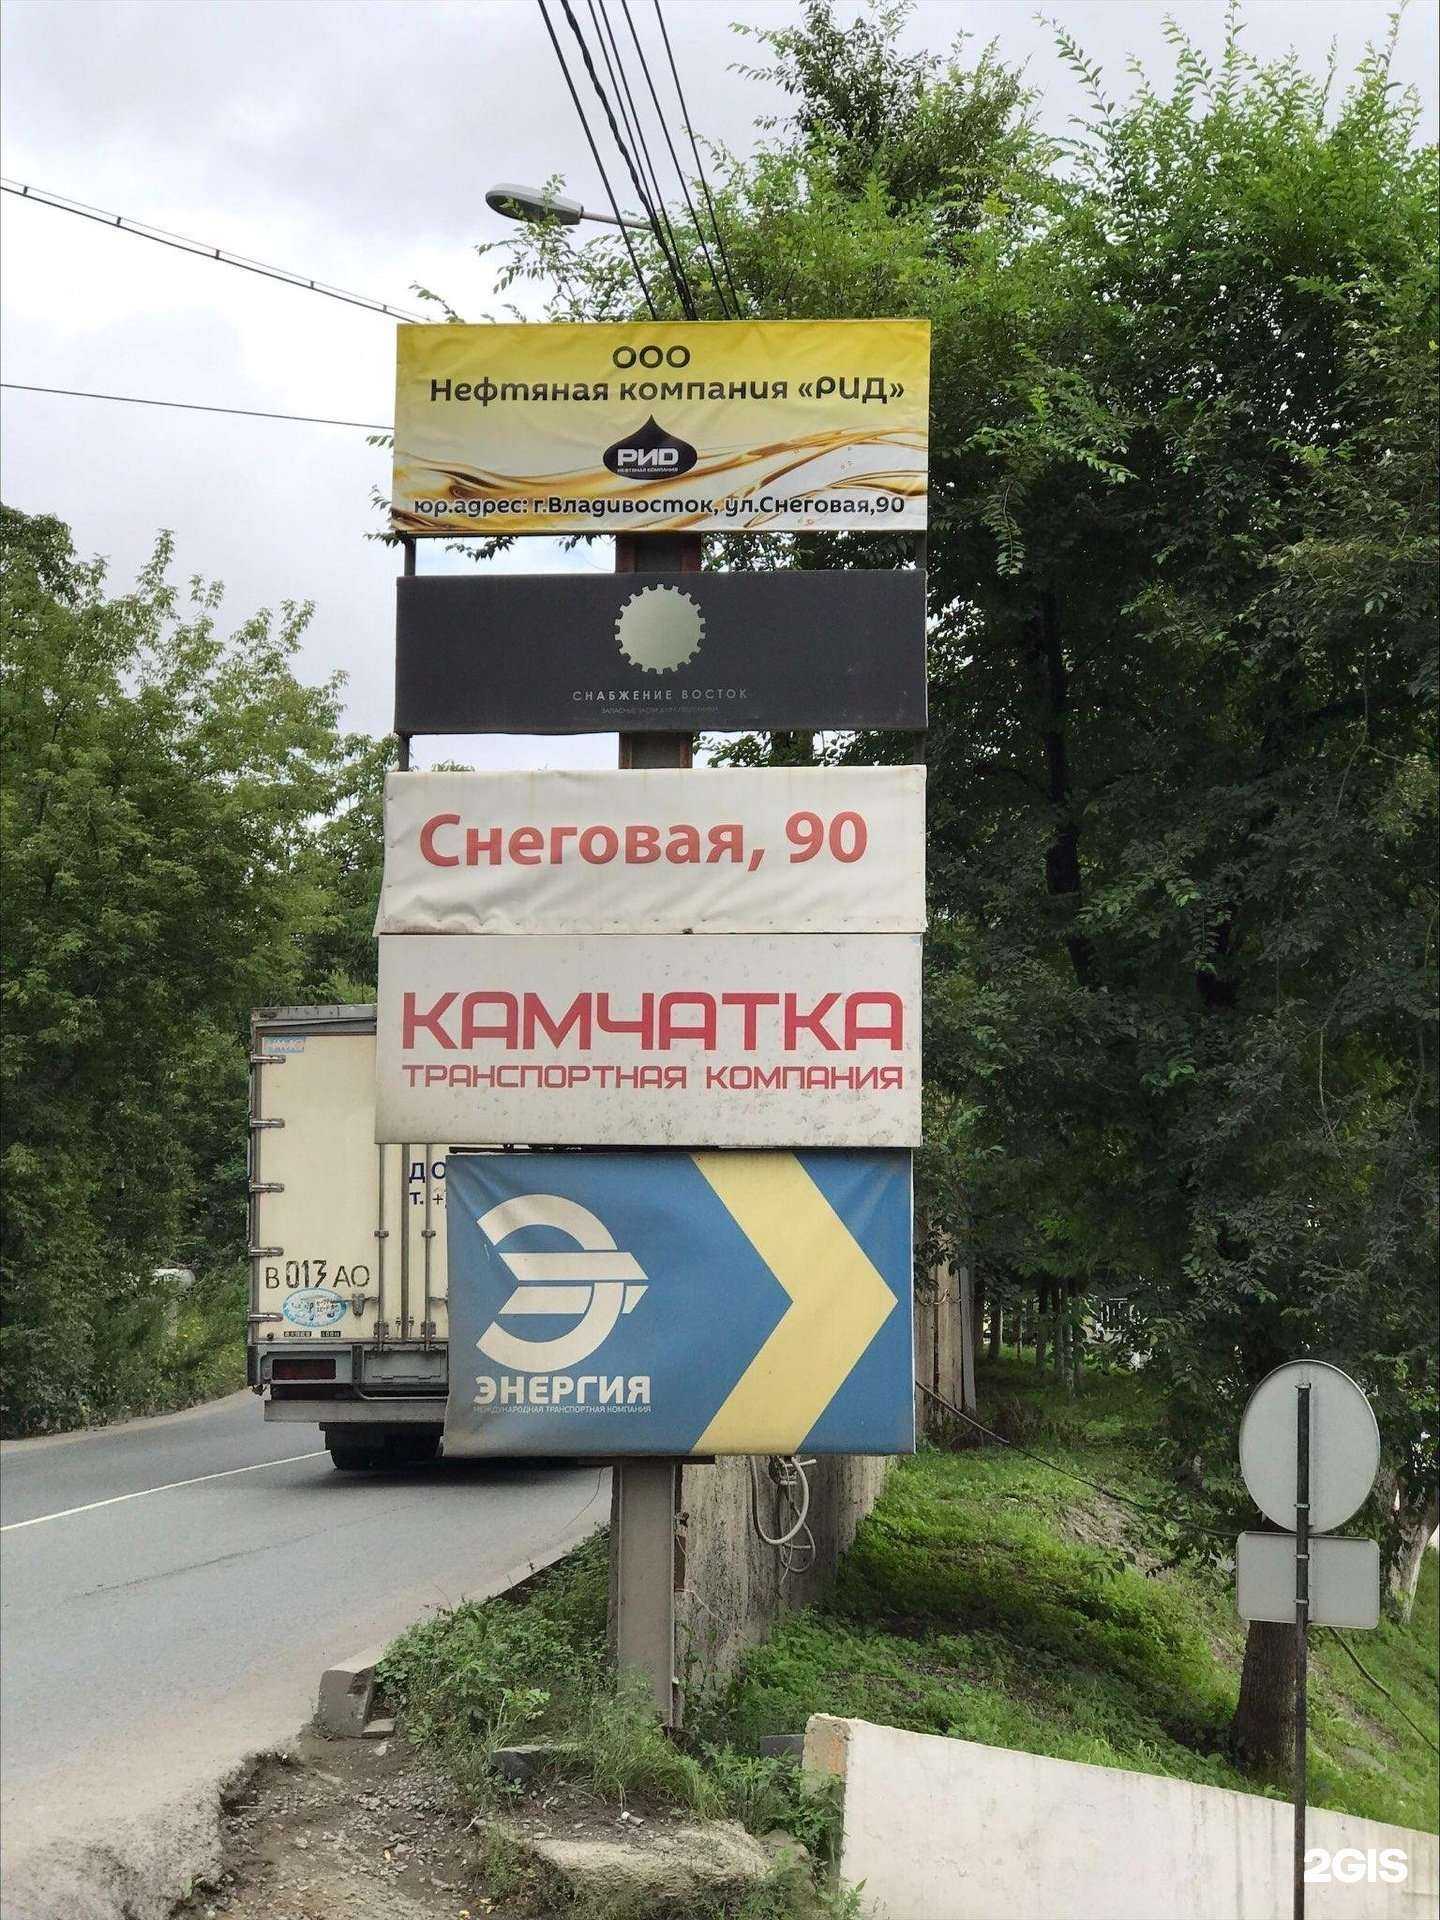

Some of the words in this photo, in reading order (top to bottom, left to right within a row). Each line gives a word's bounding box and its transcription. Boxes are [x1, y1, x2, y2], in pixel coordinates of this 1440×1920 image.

[613, 345, 691, 369] ООО
[430, 376, 608, 407] Нефтяная
[620, 381, 788, 401] компания
[798, 375, 904, 404] «РИД»
[414, 497, 528, 517] юр.адрес:
[534, 496, 718, 518] г.Владивосток,
[725, 495, 905, 517] ул.Снеговая,90
[572, 689, 672, 701] СНАБЖЕНИЕ
[681, 688, 749, 700] ВОСТОК
[420, 813, 765, 872] Снеговая,
[785, 811, 868, 864] 90
[403, 991, 904, 1051] КАМЧАТКА
[402, 1064, 687, 1089] ТРАНСПОРТНАЯ
[706, 1065, 904, 1090] КОМПАНИЯ
[473, 1375, 651, 1405] ЭНЕРГИЯ
